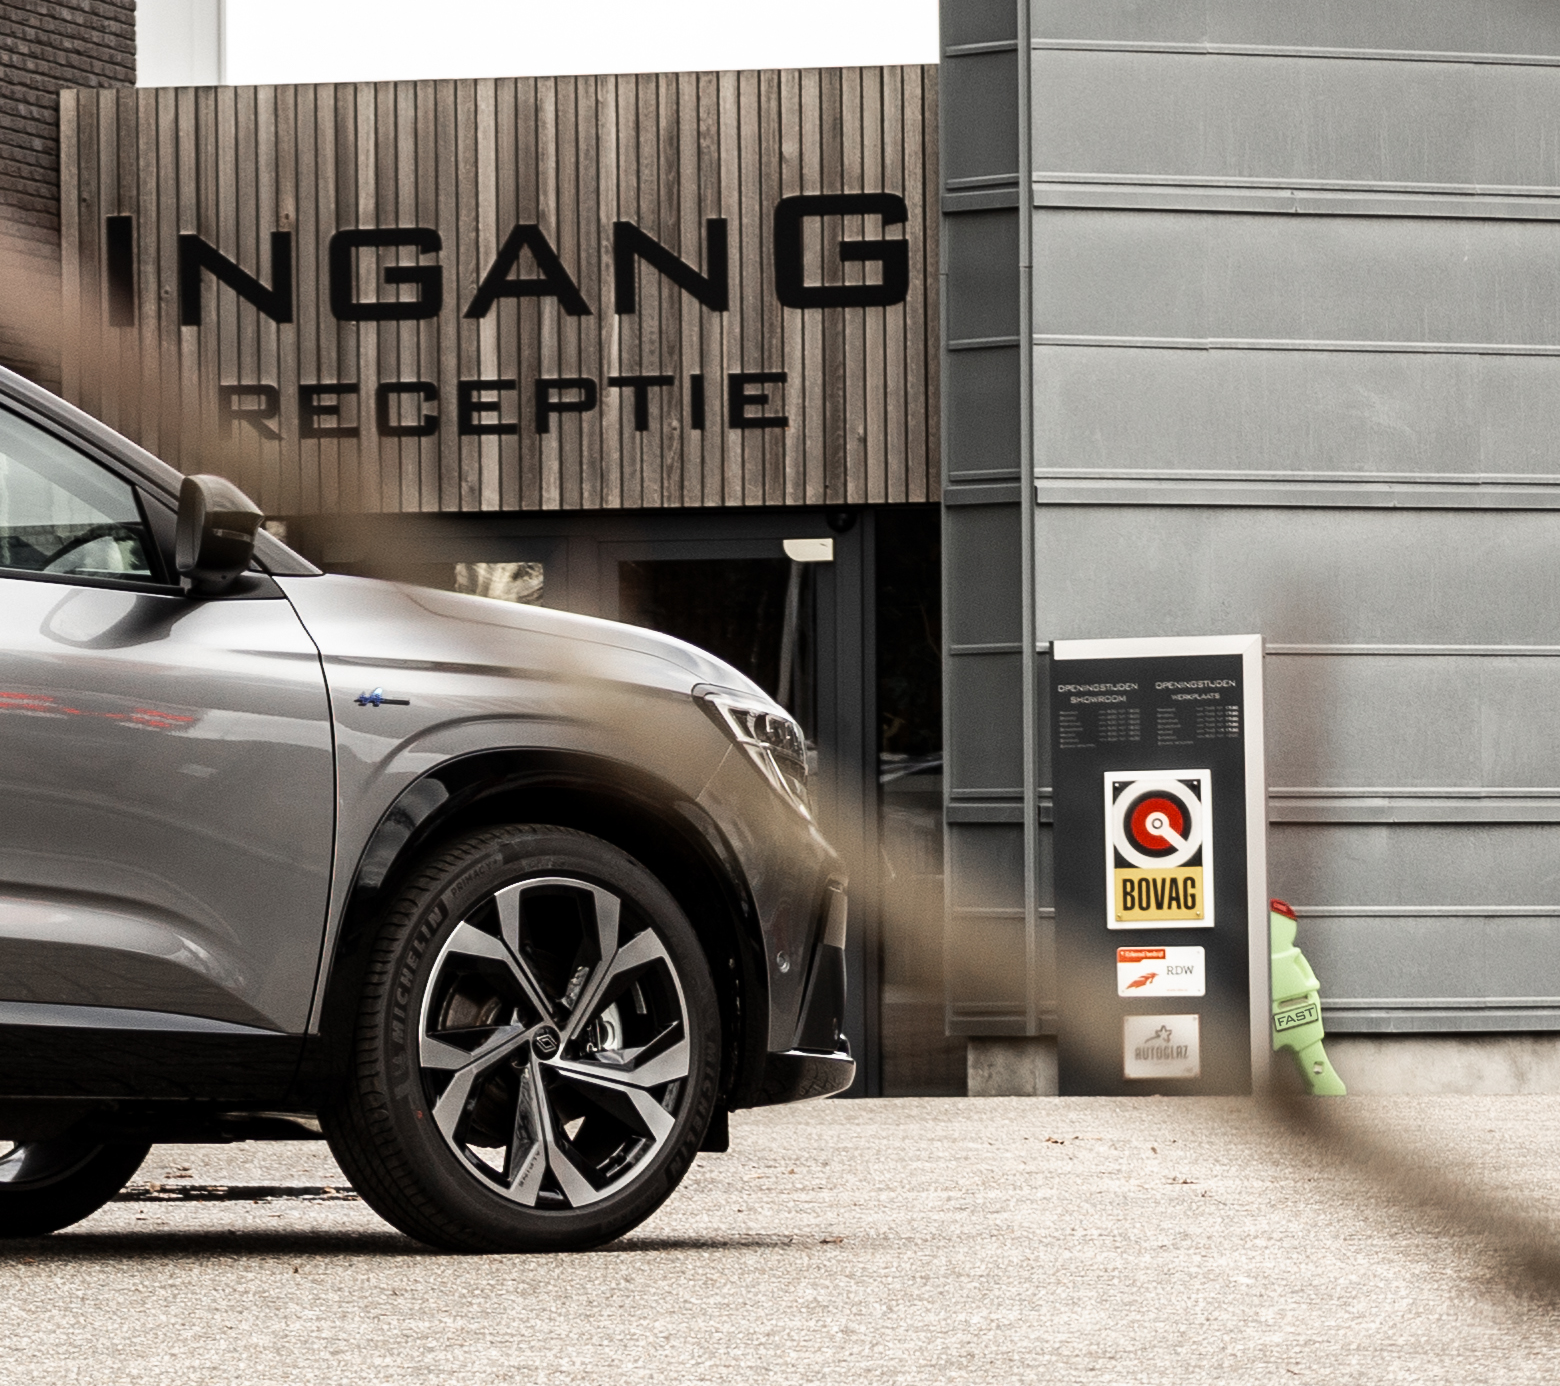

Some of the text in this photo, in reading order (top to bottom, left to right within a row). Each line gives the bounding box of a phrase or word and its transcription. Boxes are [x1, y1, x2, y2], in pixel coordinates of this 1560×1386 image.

[105, 191, 910, 327] INGANG
[218, 371, 790, 440] RECEPTIE
[1057, 683, 1138, 692] OPENINGSTIJDEN
[1155, 680, 1236, 690] OPENINGSTIJDEN
[1070, 695, 1126, 704] SHOWROOM
[1171, 692, 1220, 701] WERKPLAATS
[1121, 875, 1198, 912] BOVAG
[392, 905, 443, 1044] MICHELIN
[1166, 965, 1194, 975] RDW
[1277, 1007, 1315, 1026] FAST
[1134, 1044, 1189, 1060] AUTOGLAZ
